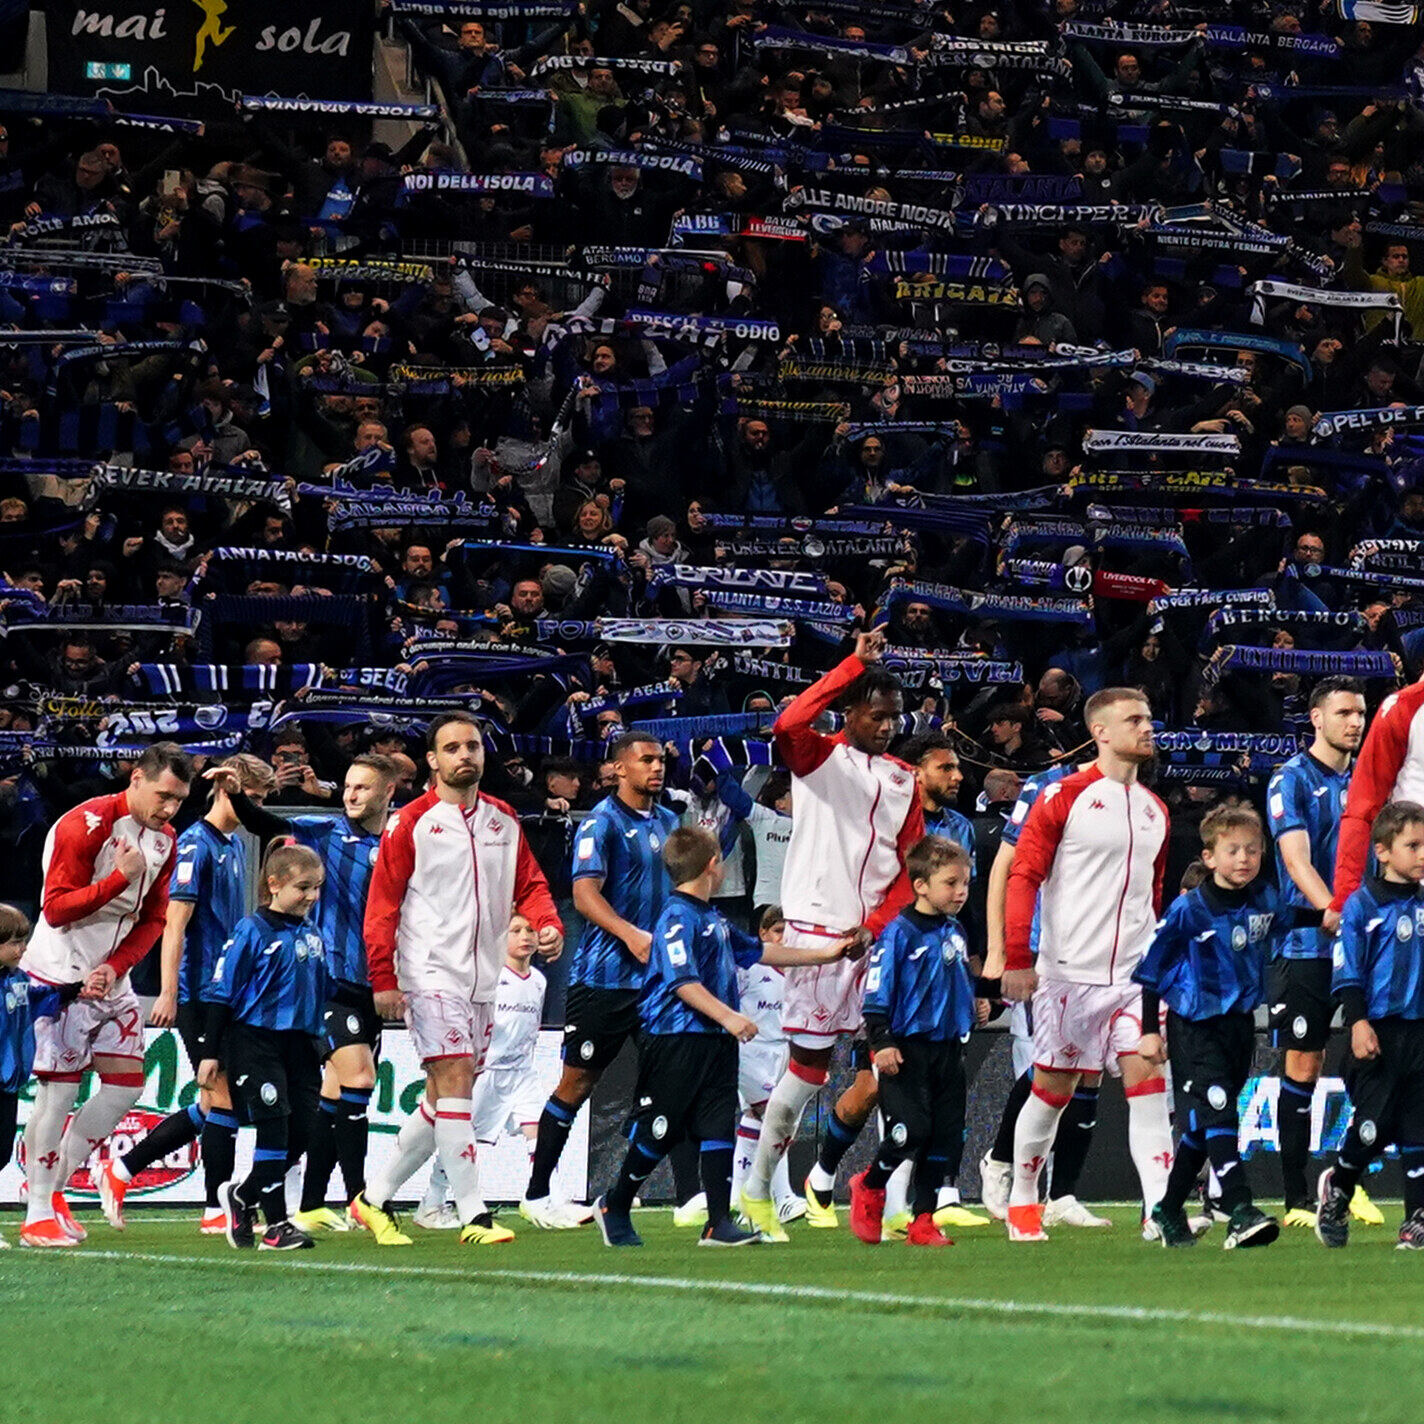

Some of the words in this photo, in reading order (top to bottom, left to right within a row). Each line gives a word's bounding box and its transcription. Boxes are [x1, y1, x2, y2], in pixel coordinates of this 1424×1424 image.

[71, 7, 167, 42] mai
[255, 15, 352, 58] sola
[1207, 30, 1269, 47] ATALANTA
[1278, 37, 1338, 56] BERGAMO
[404, 174, 434, 190] NOI
[438, 174, 535, 191] DELL'ISOLA
[735, 323, 781, 342] ODIO
[1333, 414, 1372, 433] PEL
[1379, 409, 1407, 425] DE
[1103, 571, 1146, 584] LIVERPOOL
[809, 599, 844, 617] LAZIO
[1222, 610, 1349, 627] BERGAMO
